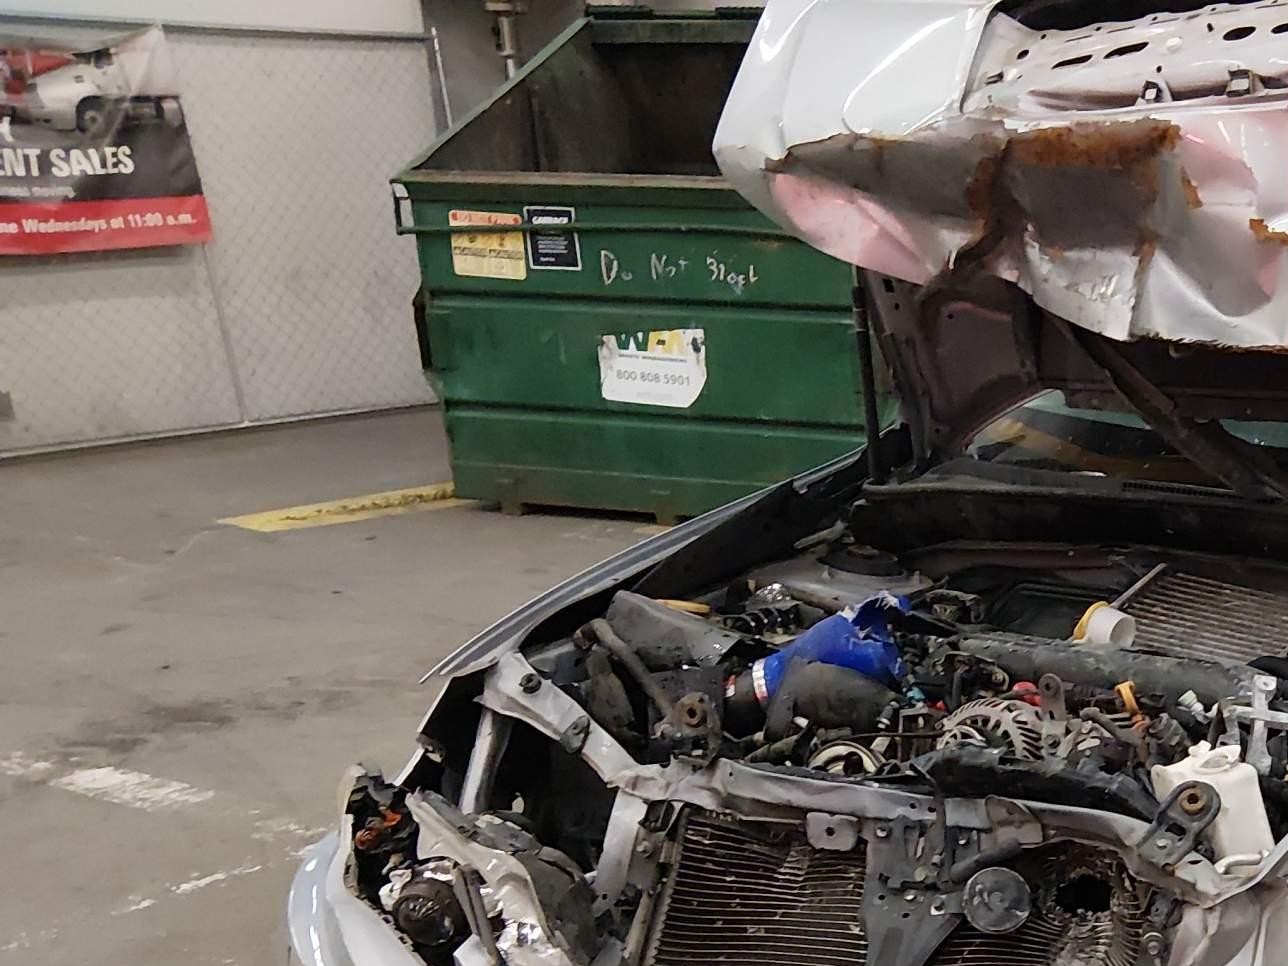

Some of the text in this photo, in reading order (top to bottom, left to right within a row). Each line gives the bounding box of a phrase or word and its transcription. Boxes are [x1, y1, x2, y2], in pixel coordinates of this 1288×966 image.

[49, 145, 135, 178] SALES
[22, 217, 107, 233] Wednesdays
[110, 215, 125, 229] at
[600, 249, 633, 286] Do
[651, 252, 689, 281] Not
[616, 369, 691, 386] 800 808 5901
